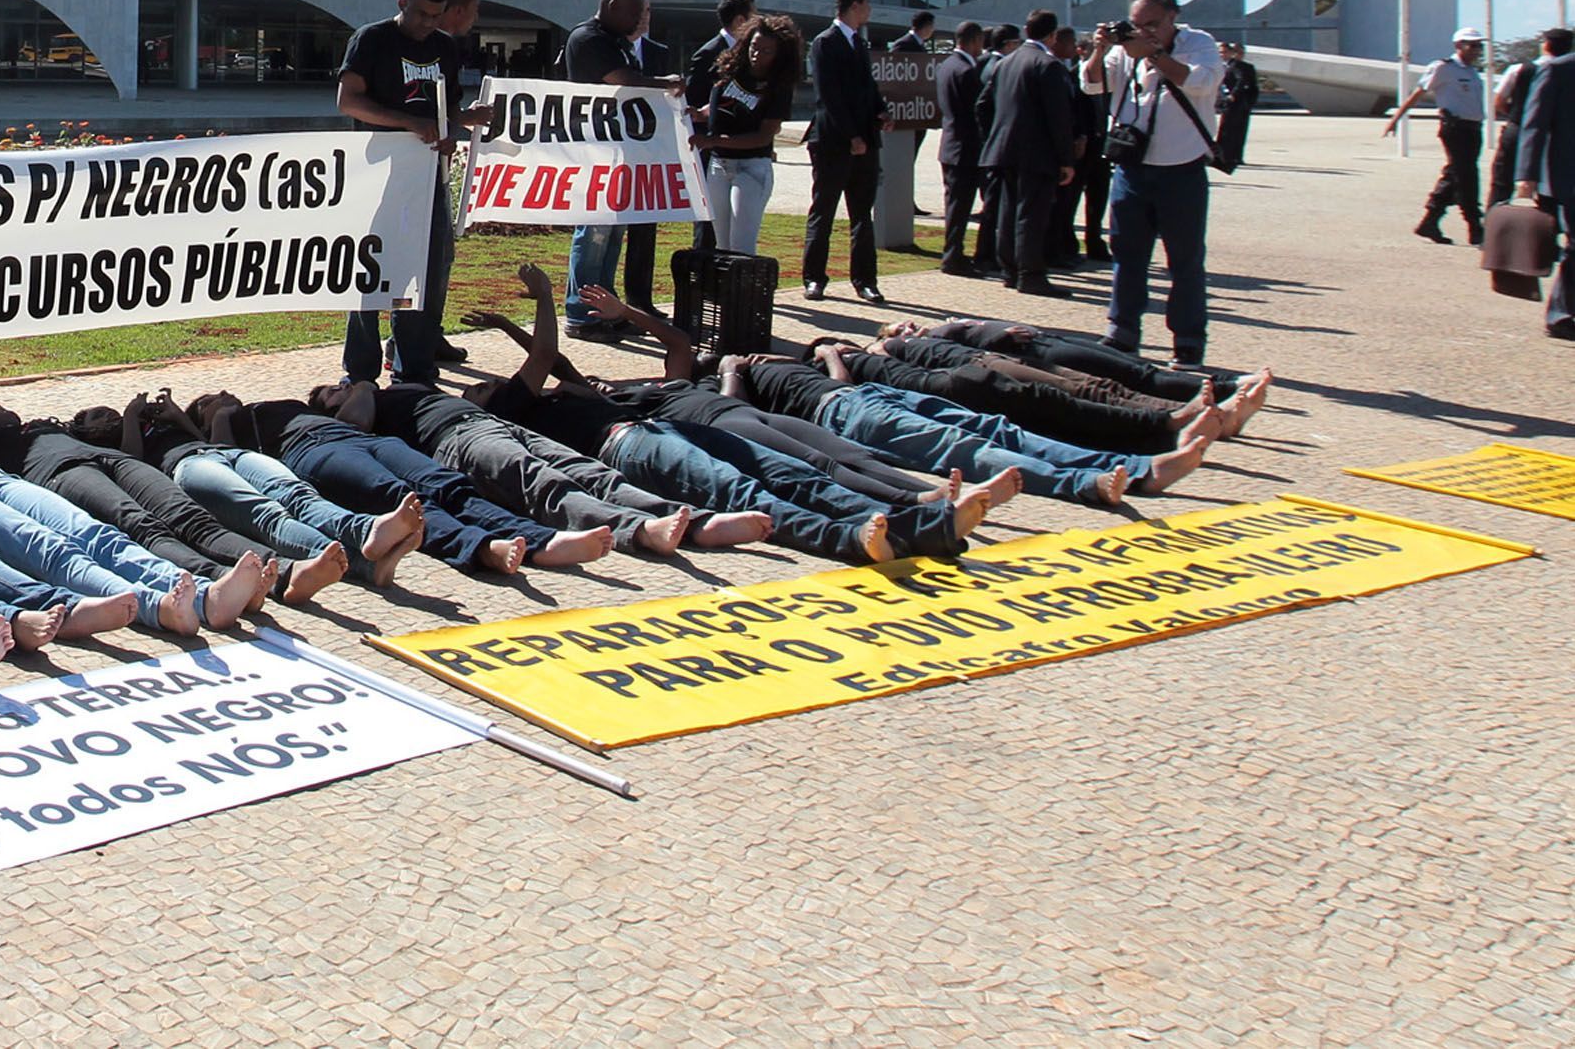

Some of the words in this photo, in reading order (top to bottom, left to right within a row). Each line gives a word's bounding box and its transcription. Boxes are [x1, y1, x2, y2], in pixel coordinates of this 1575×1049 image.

[871, 56, 919, 81] alácio
[926, 58, 943, 81] d
[882, 96, 936, 120] analto
[23, 160, 75, 224] P/
[80, 153, 253, 220] NEGROS
[258, 149, 346, 210] (as)
[522, 165, 581, 210] DE
[181, 227, 391, 303] PÚBLICOS.
[424, 591, 858, 676] REPARAÇÕES
[843, 583, 911, 605] E
[579, 649, 791, 698] PARA
[769, 638, 845, 664] O
[825, 608, 1015, 647] POVO
[832, 634, 1113, 692] Educafro
[27, 671, 262, 719] TERRA...
[131, 677, 370, 744] NEGRO!
